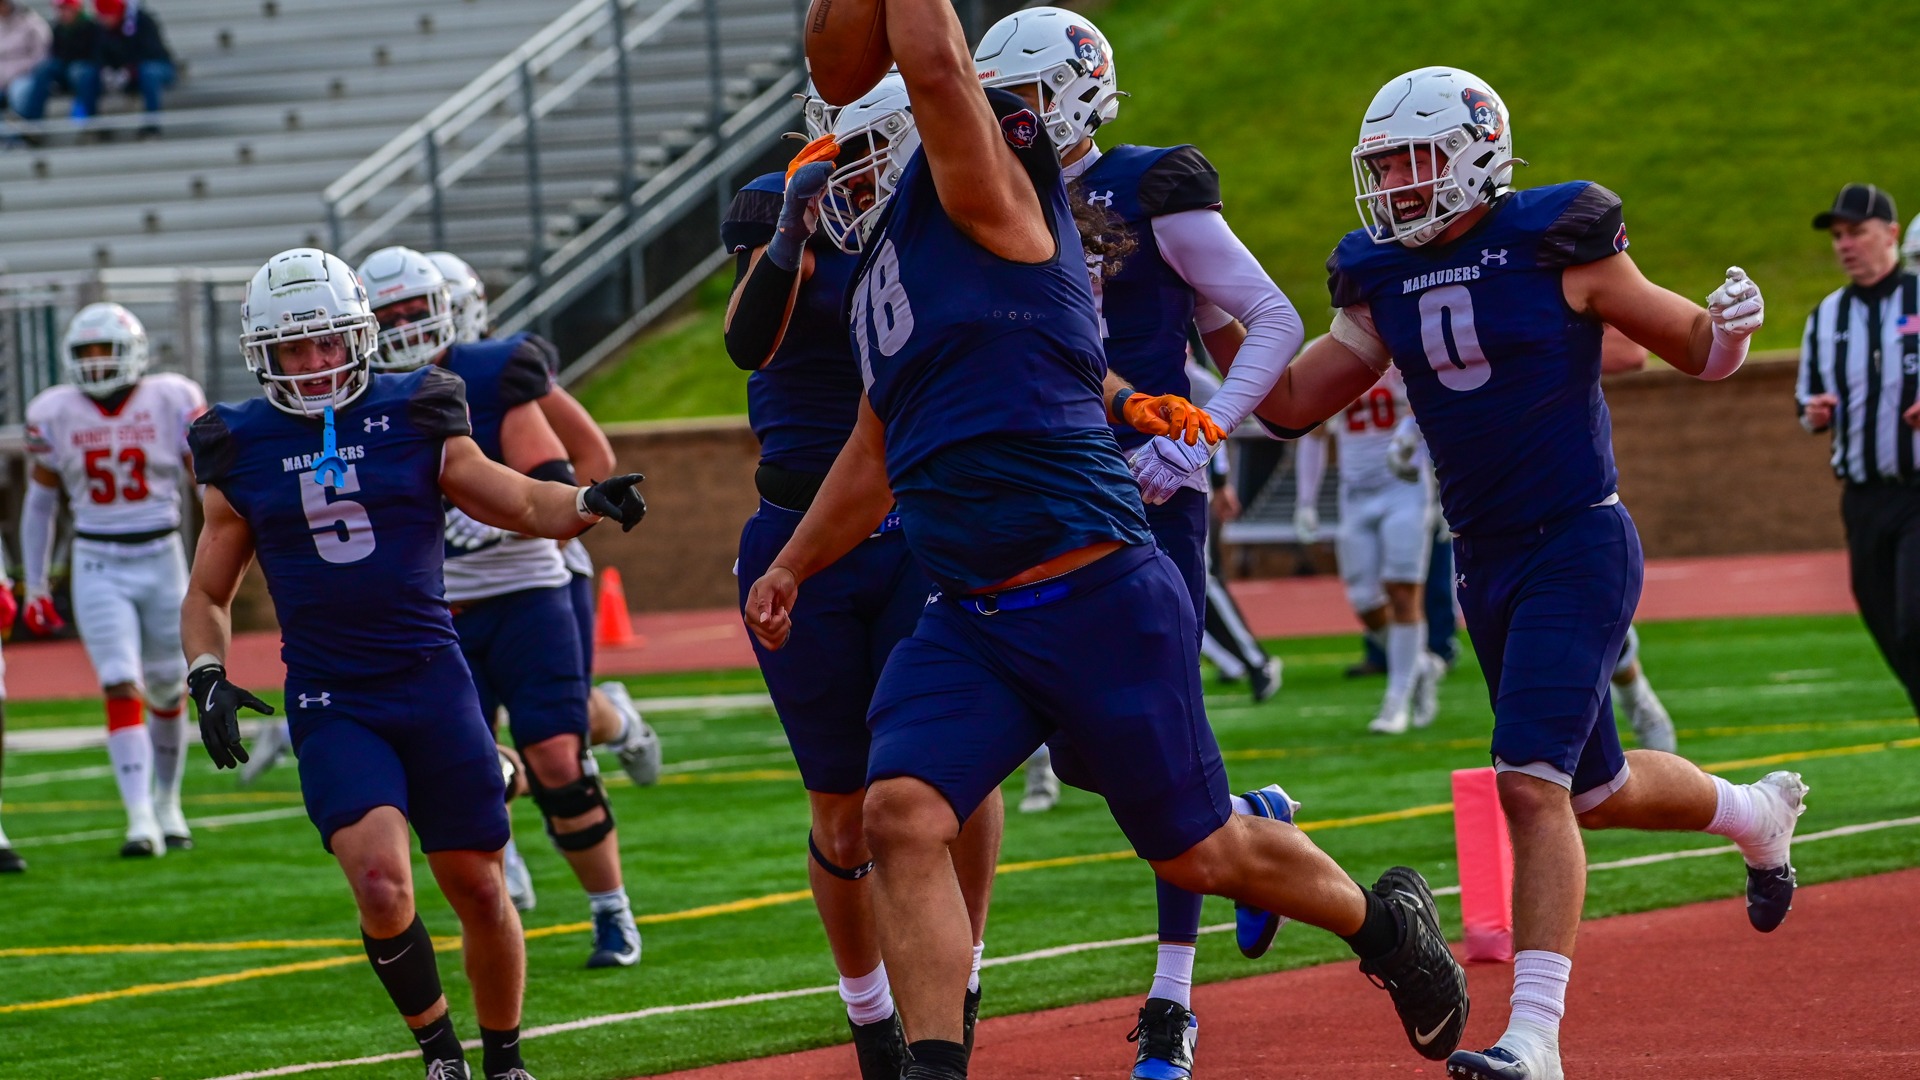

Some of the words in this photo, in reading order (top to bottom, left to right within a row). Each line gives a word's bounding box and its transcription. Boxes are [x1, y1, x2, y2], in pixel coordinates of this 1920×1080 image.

[850, 238, 915, 395] 78
[1402, 265, 1481, 294] MARAUDERS
[1418, 284, 1492, 392] 0
[1347, 388, 1395, 431] 20
[84, 448, 149, 504] 53
[298, 463, 376, 564] 5
